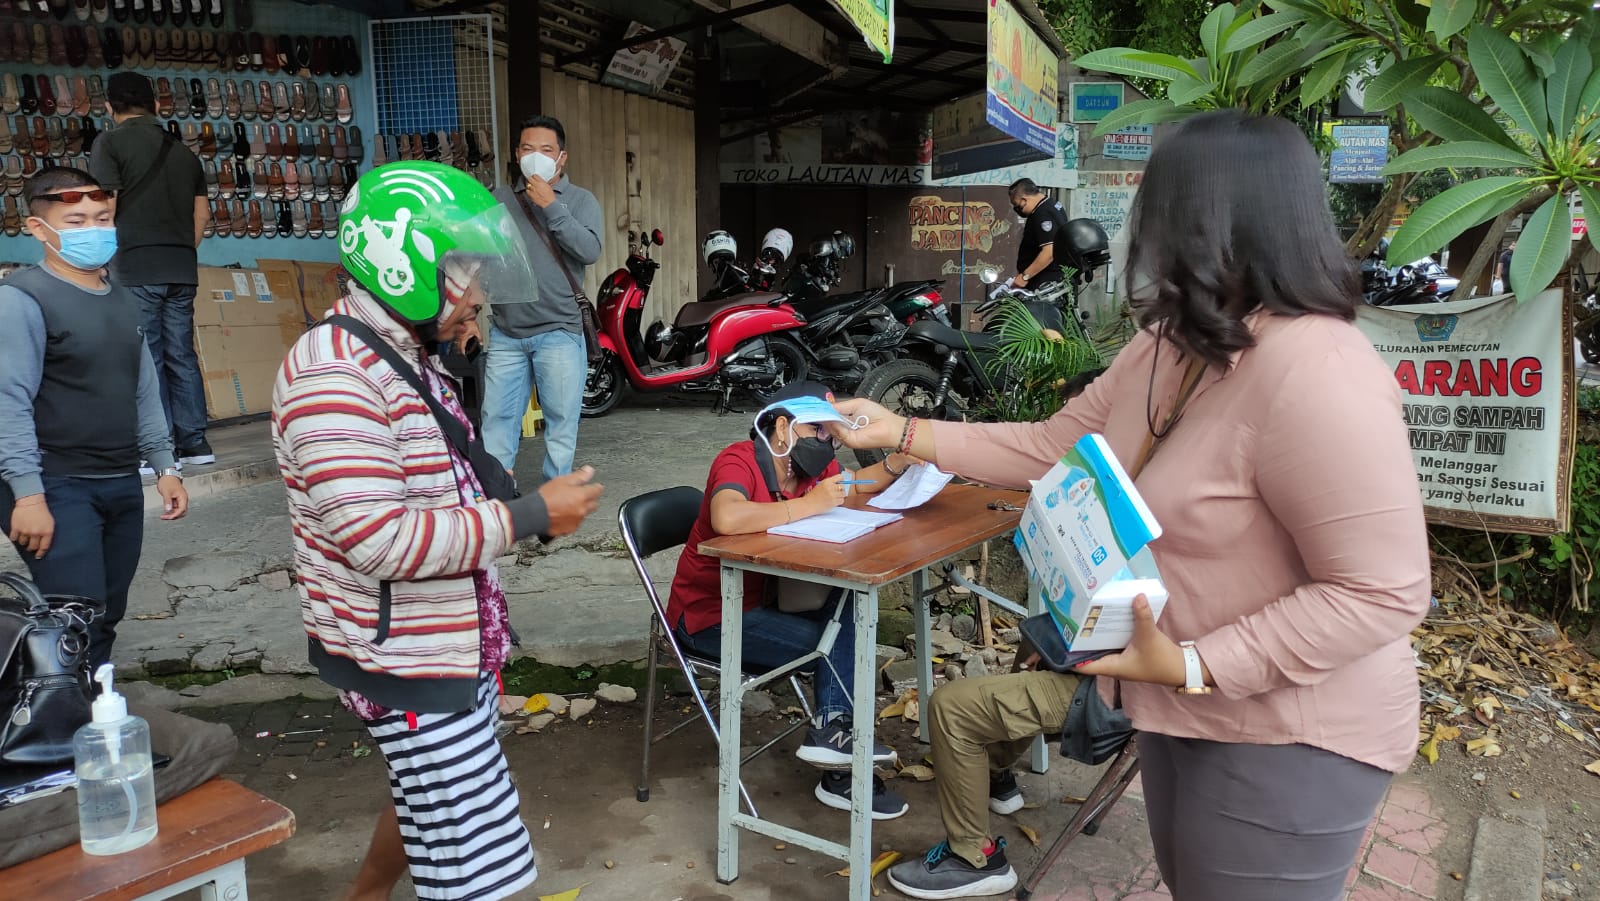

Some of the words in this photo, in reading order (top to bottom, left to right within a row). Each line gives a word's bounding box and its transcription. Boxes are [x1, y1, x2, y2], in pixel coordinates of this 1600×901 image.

[1368, 137, 1386, 147] MAS
[735, 169, 780, 183] TOKO
[787, 165, 874, 183] LAUTAN
[879, 167, 925, 184] MAS
[909, 205, 992, 226] PANCING
[1374, 344, 1434, 354] ELURAHAN
[1438, 343, 1500, 353] PEMECUTAN
[1394, 357, 1542, 397] ARANG
[1454, 405, 1545, 430] SAMPAH
[1408, 429, 1472, 452] MPAT
[1475, 432, 1506, 455] INI
[1420, 456, 1498, 474] Melanggar
[1437, 472, 1487, 489] Sangsi
[1490, 477, 1545, 492] Sesuai
[1426, 489, 1463, 503] yang
[1467, 490, 1525, 507] berlaku
